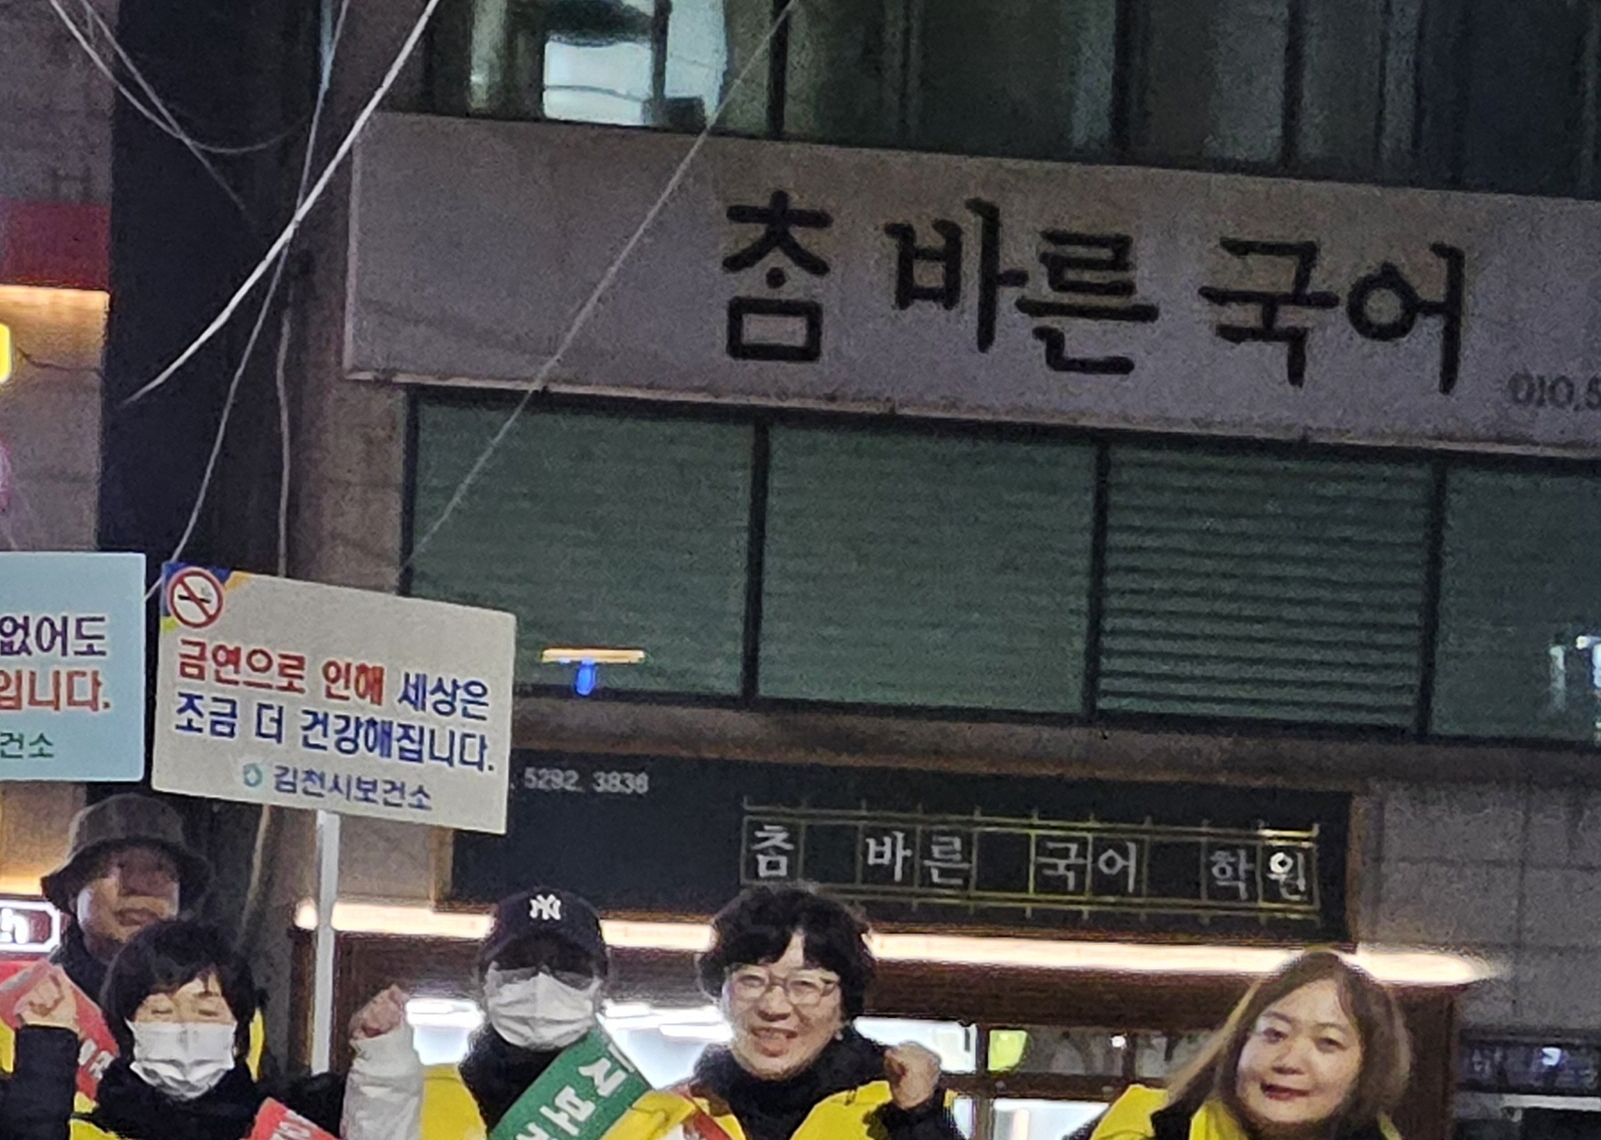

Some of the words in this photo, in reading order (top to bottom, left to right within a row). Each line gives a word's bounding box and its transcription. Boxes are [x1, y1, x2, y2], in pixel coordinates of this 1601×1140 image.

[885, 198, 1161, 375] 바른
[1201, 237, 1467, 396] 국어
[179, 638, 306, 694] 금연으로
[322, 660, 385, 706] 인해
[398, 671, 489, 721] 세상은
[175, 691, 238, 739] 조금
[256, 702, 284, 744] 더
[301, 708, 495, 772] 건강해집니다.
[274, 765, 433, 811] 김천시보건소
[866, 831, 972, 886] 바른
[1037, 841, 1137, 893] 국어
[1210, 847, 1306, 900] 학원
